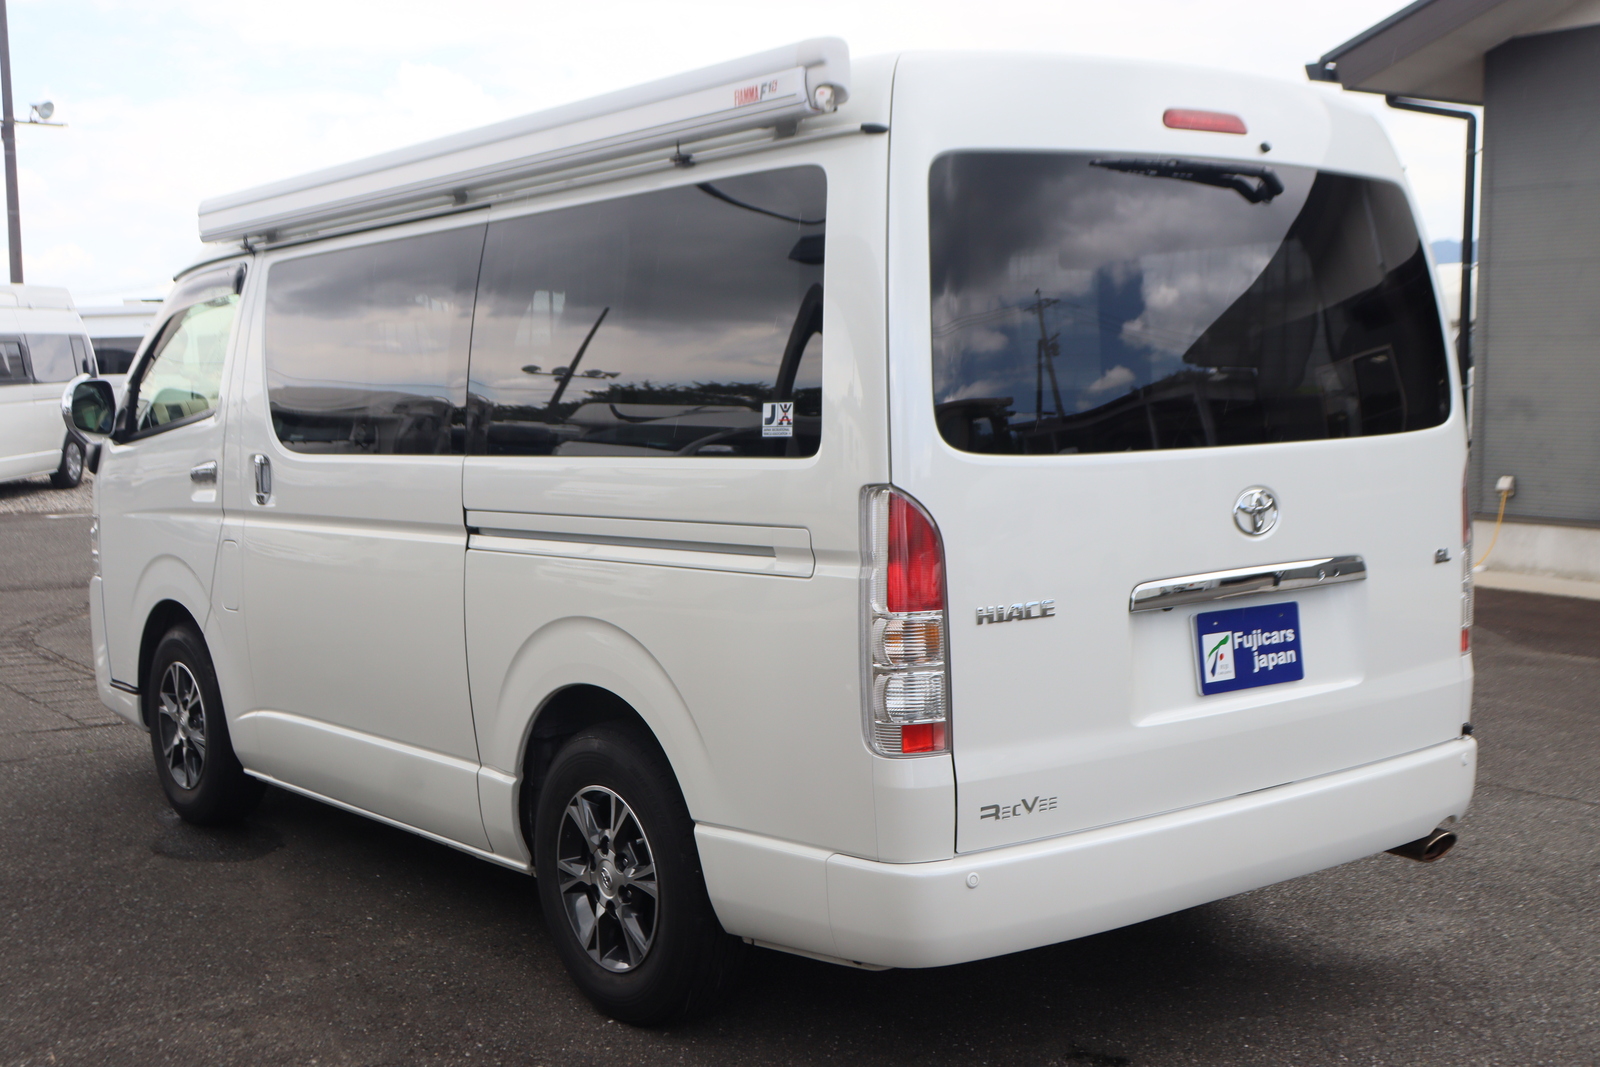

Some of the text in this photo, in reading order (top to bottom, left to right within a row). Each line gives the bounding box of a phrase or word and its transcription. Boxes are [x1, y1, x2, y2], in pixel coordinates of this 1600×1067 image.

[734, 85, 760, 108] FIAMMA
[976, 599, 1056, 625] HIACE
[1233, 629, 1295, 651] Fujicars
[1253, 650, 1297, 673] japan
